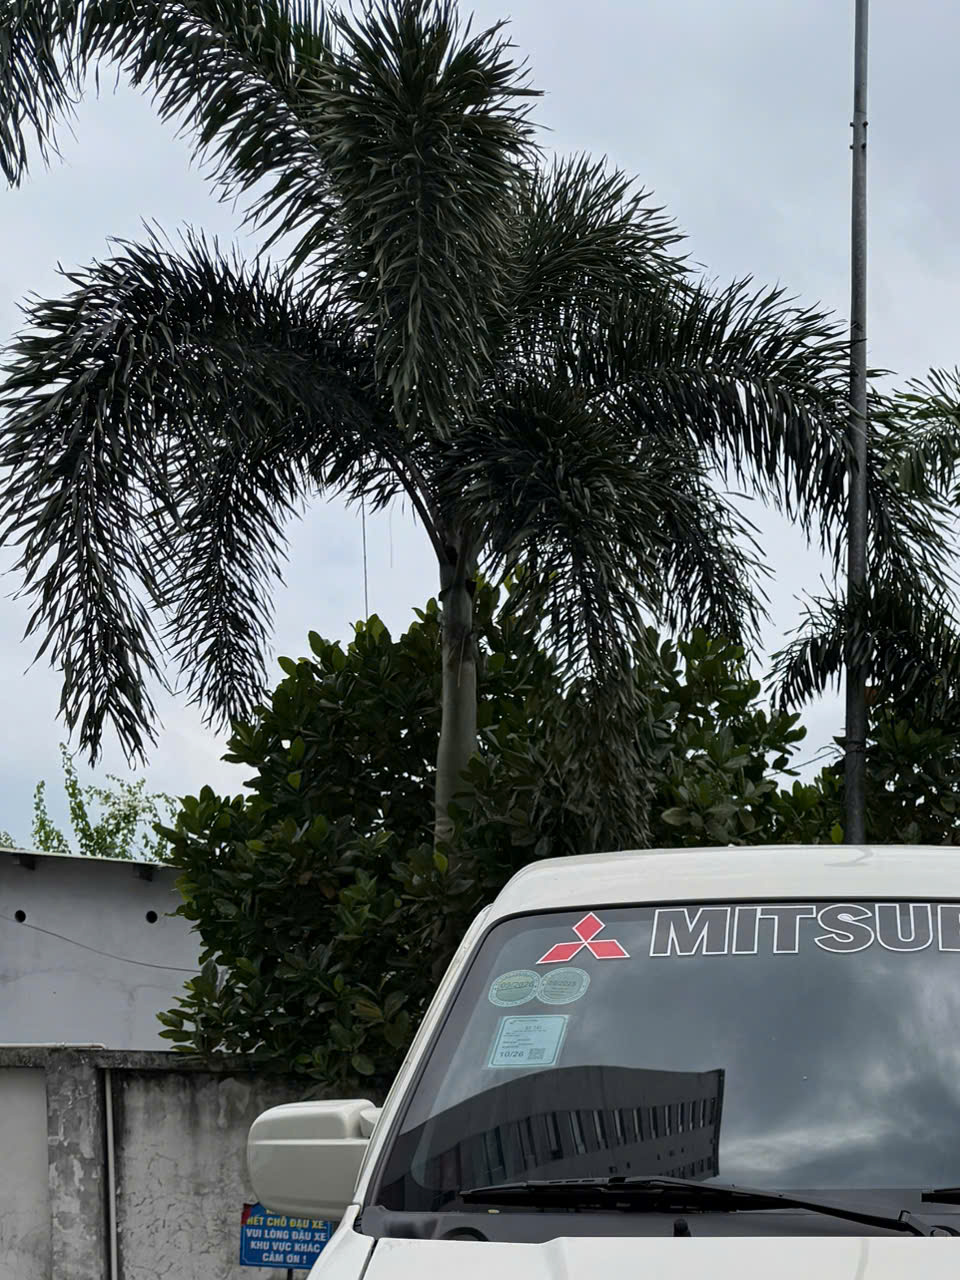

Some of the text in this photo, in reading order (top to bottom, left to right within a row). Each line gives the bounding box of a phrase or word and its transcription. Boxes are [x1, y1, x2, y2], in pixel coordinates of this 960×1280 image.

[247, 1214, 264, 1226] HẾT
[246, 1228, 262, 1238] VUI
[264, 1227, 289, 1240] LÒNG
[314, 1232, 328, 1242] XE
[250, 1240, 270, 1251] KHU
[294, 1242, 320, 1254] KHÁC
